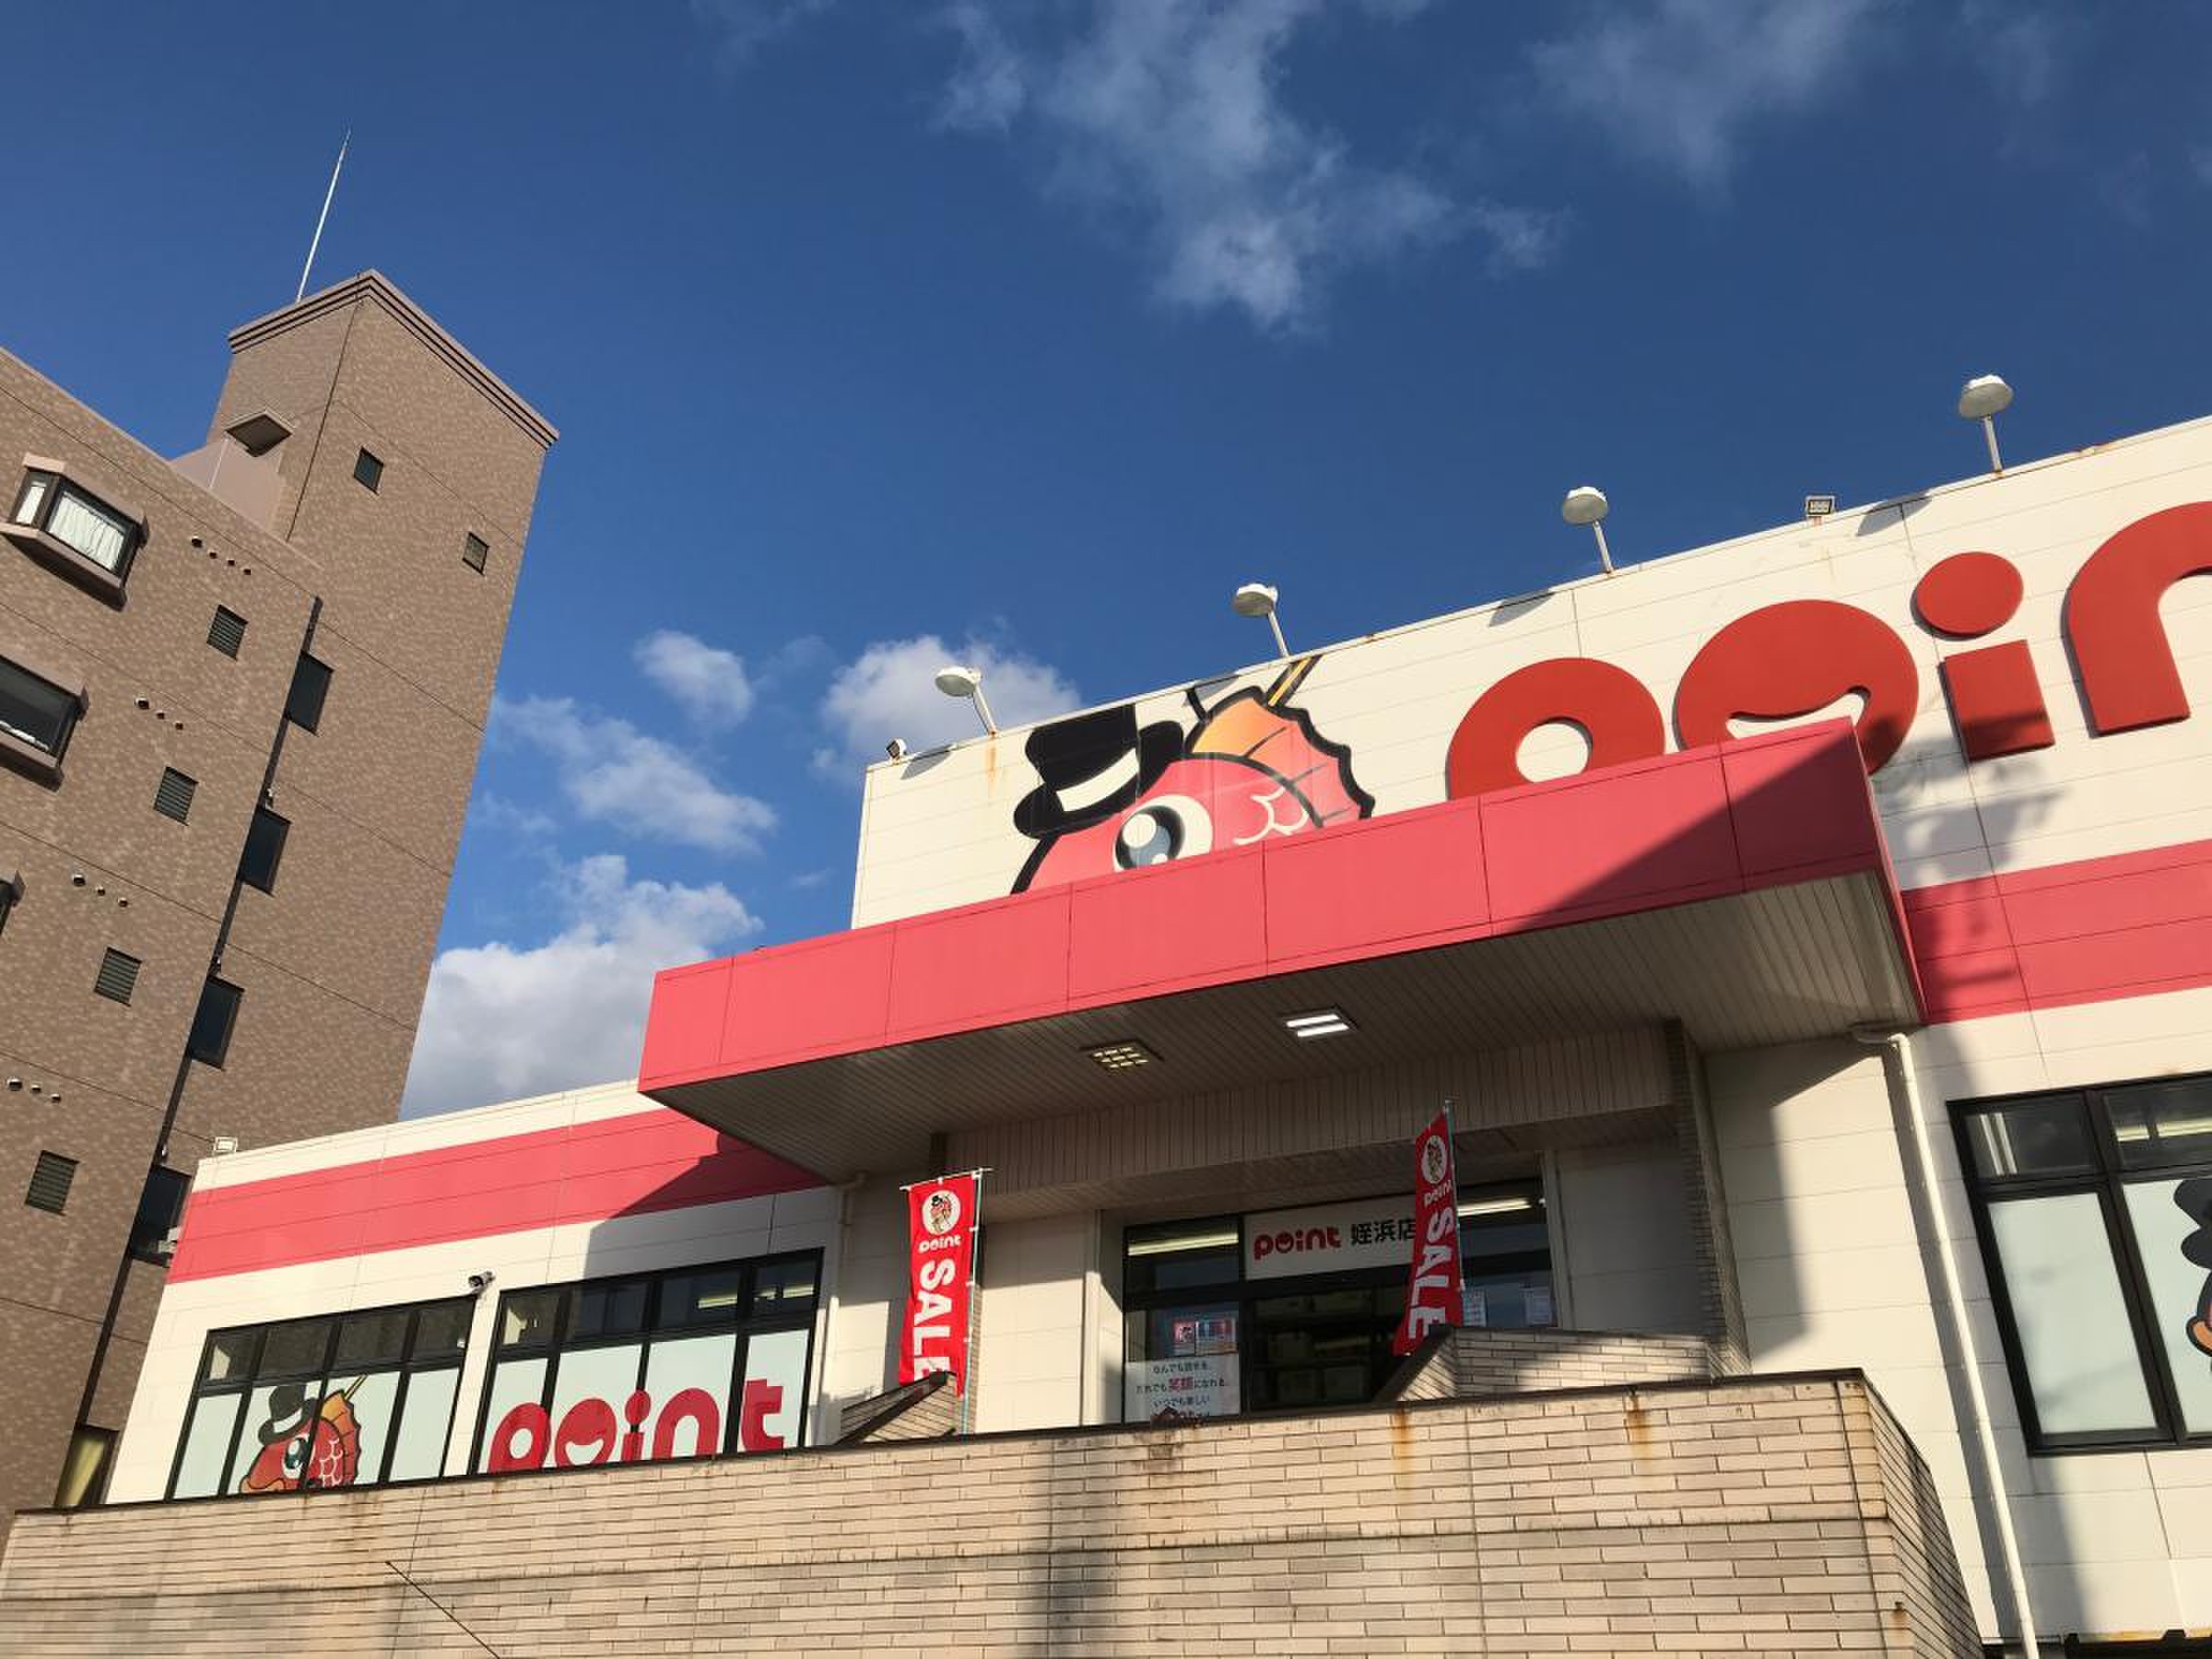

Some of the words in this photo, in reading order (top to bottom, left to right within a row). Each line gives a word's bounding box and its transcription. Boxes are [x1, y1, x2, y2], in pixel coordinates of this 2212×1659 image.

[918, 1234, 961, 1253] point
[1253, 1226, 1342, 1260] point
[1350, 1218, 1416, 1245] 姪浜店
[1407, 1207, 1454, 1339] SALE
